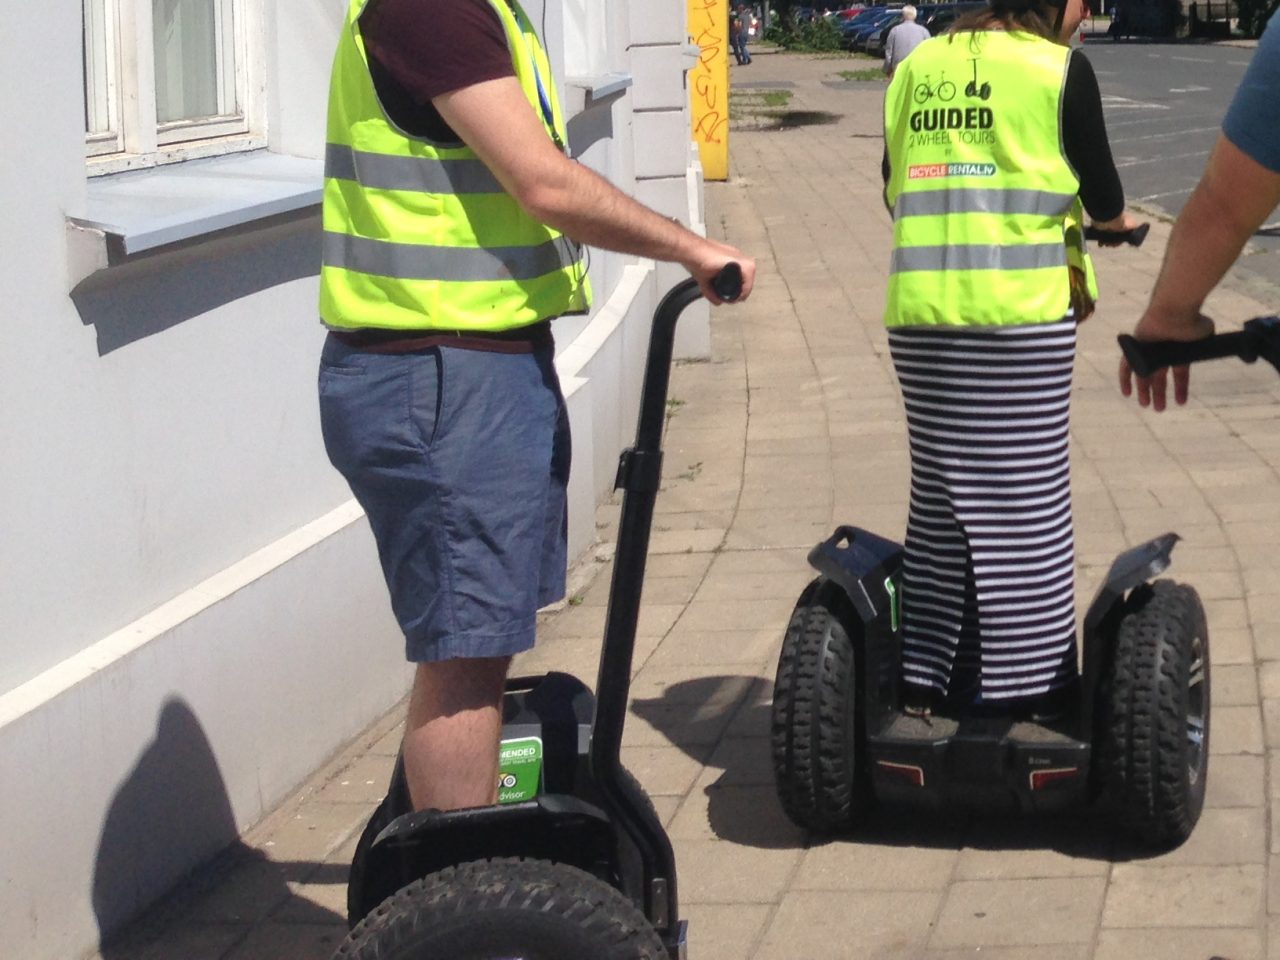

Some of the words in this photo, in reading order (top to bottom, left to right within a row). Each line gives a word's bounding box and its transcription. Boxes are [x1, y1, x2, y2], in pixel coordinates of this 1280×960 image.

[910, 107, 994, 133] GUIDED
[909, 134, 915, 148] 2
[917, 131, 952, 147] WHEEL
[958, 130, 996, 145] TOURS
